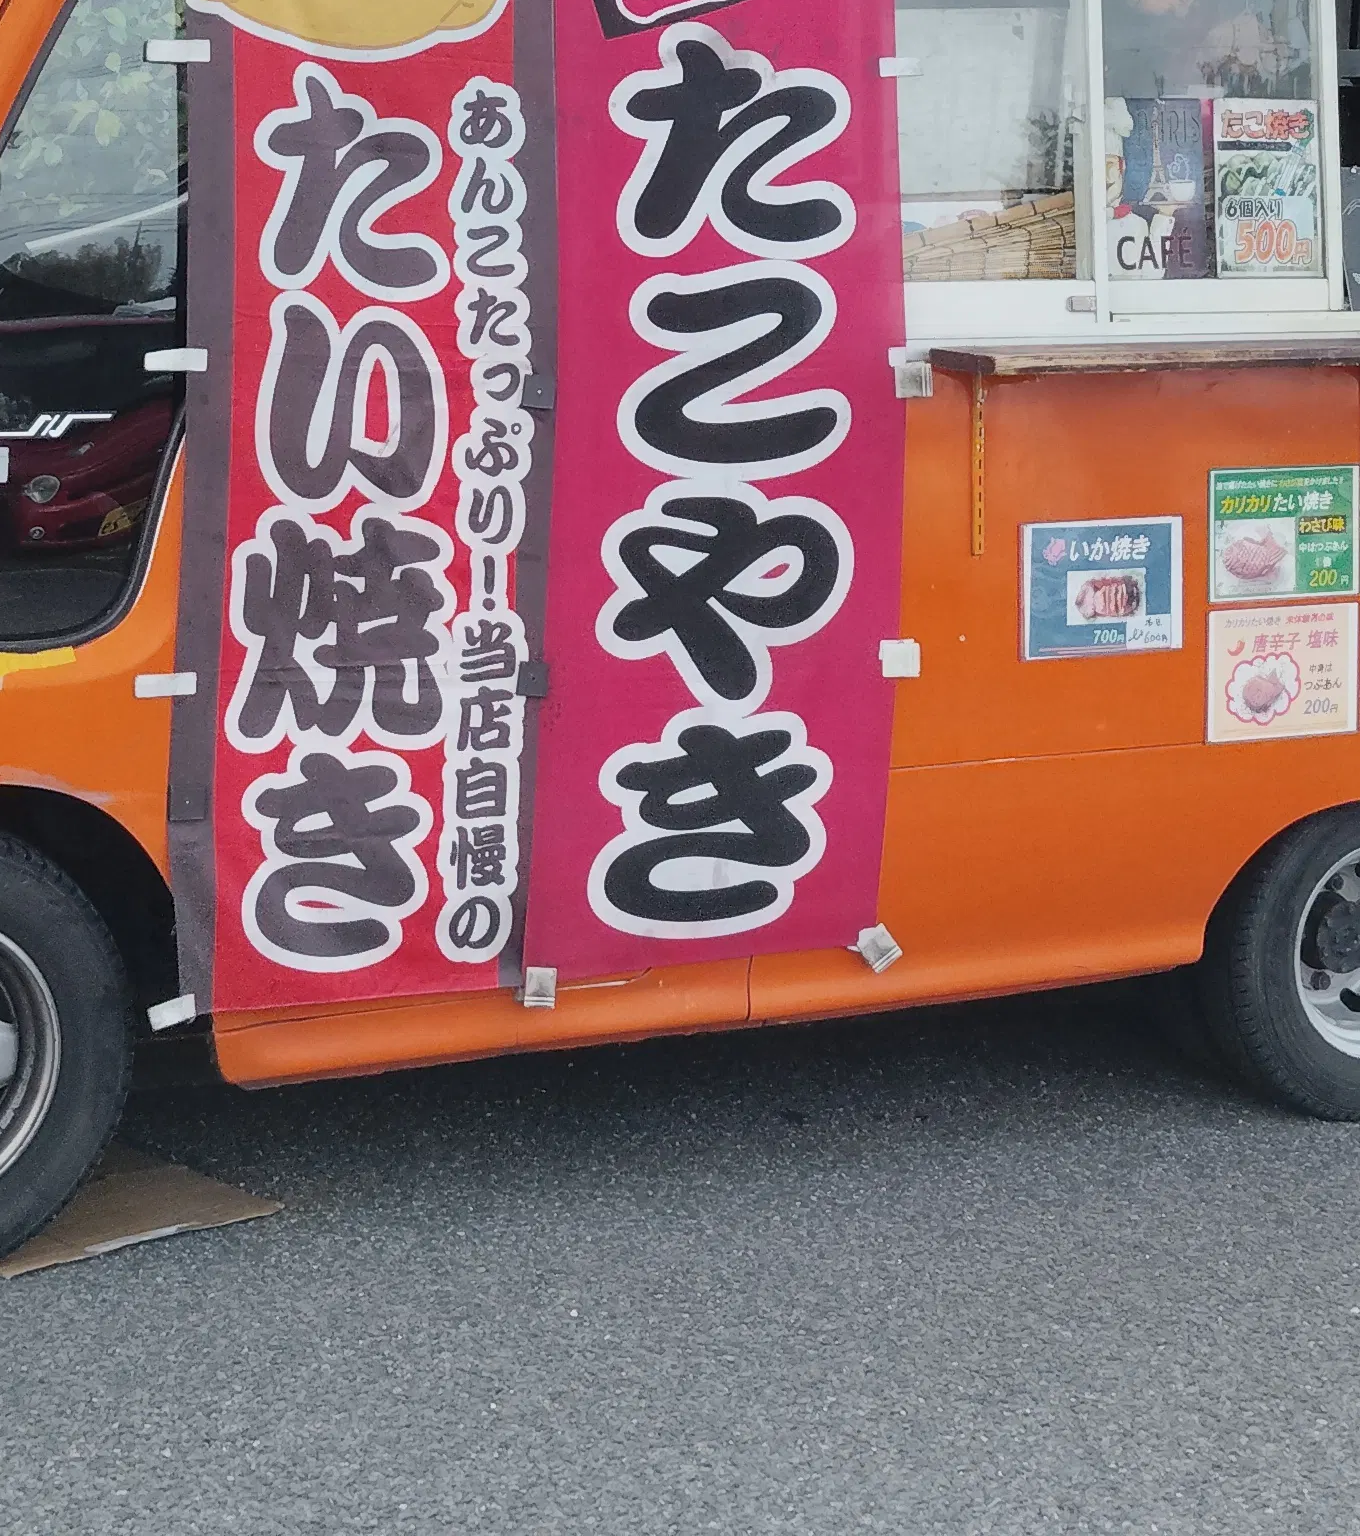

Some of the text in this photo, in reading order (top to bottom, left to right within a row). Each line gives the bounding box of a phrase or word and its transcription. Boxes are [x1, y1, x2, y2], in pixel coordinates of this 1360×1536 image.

[1220, 108, 1313, 140] たこ焼き
[1225, 198, 1283, 220] 6個入り
[1115, 225, 1193, 271] CAFÉ
[1234, 218, 1313, 266] 500円
[594, 26, 854, 936] たこやき
[228, 64, 454, 970] たい焼き
[1219, 490, 1334, 514] カリカリたい焼き
[1069, 534, 1151, 562] いか焼き
[1252, 629, 1340, 653] 唐辛子 塩味
[1304, 697, 1339, 715] 200円
